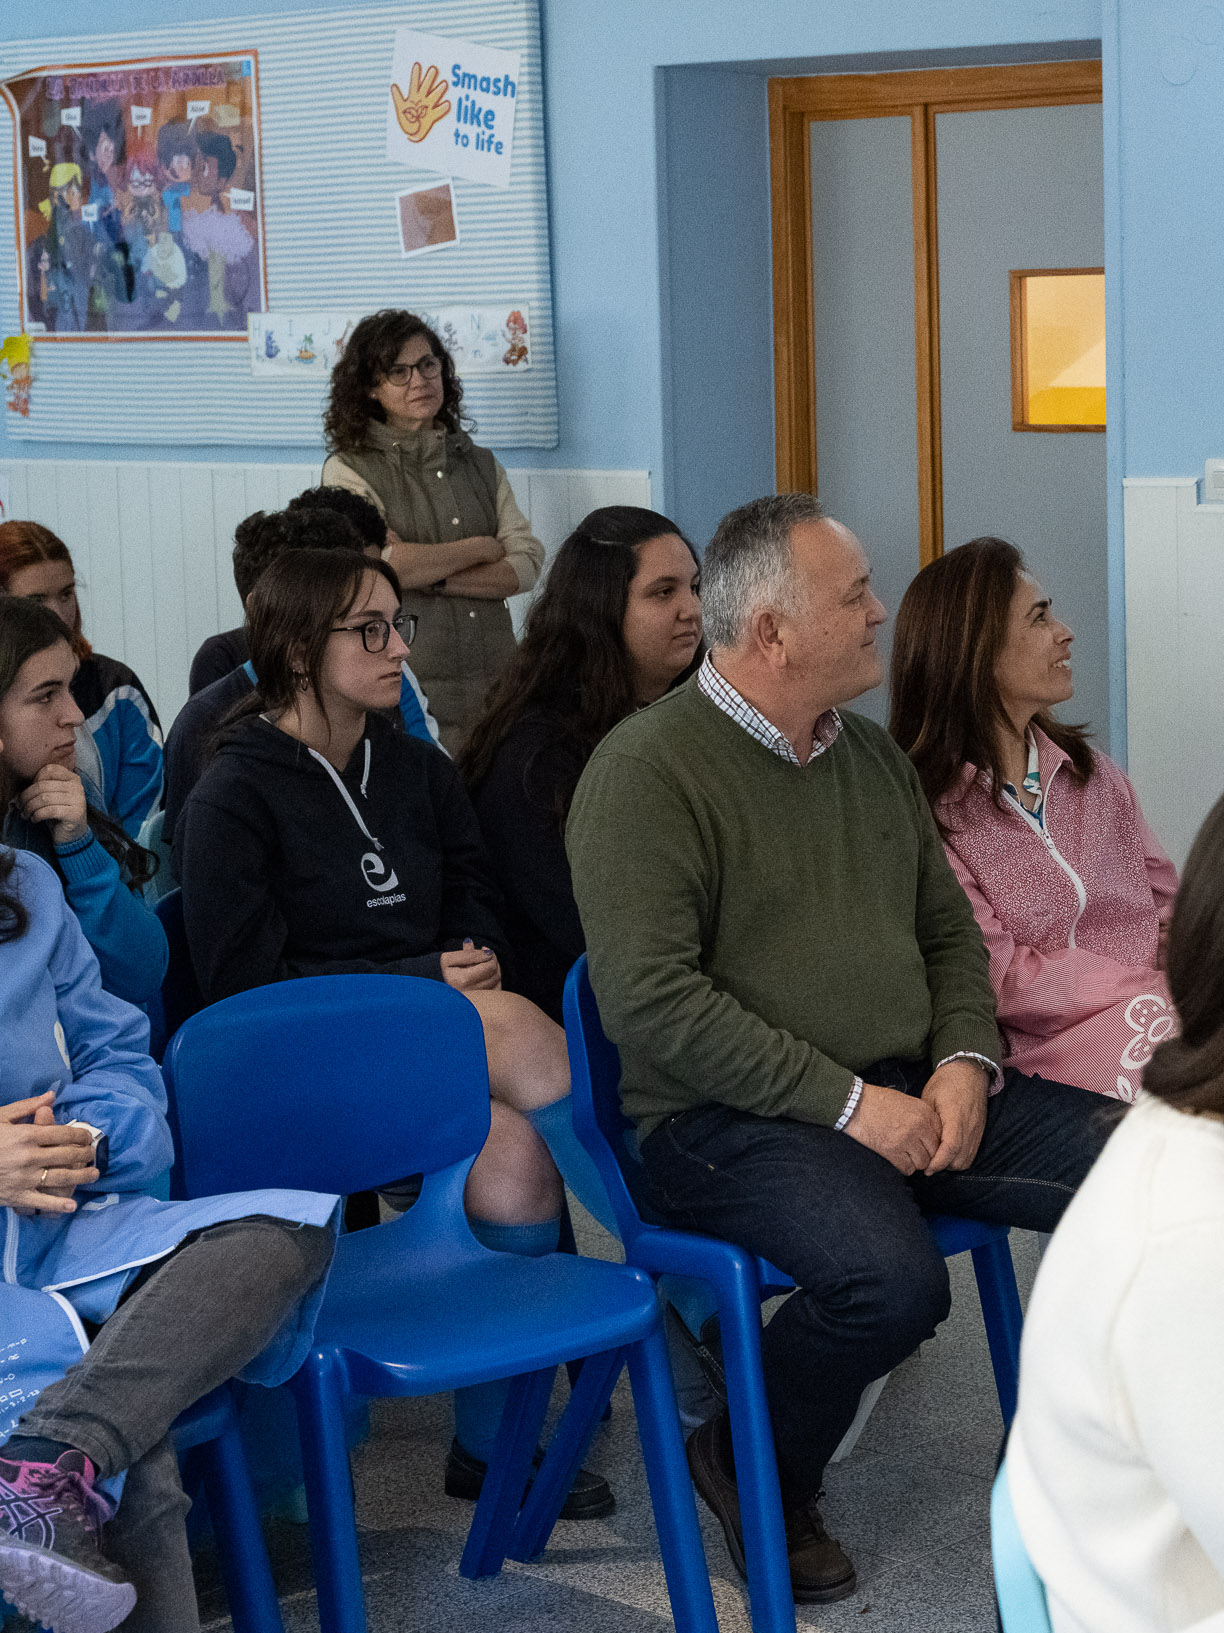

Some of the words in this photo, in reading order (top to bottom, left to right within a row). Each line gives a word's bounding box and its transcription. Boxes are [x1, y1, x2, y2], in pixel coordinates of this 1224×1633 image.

[451, 63, 516, 98] Smash
[456, 93, 496, 130] like
[454, 128, 469, 148] to
[475, 130, 504, 155] life
[366, 893, 407, 908] escolapias
